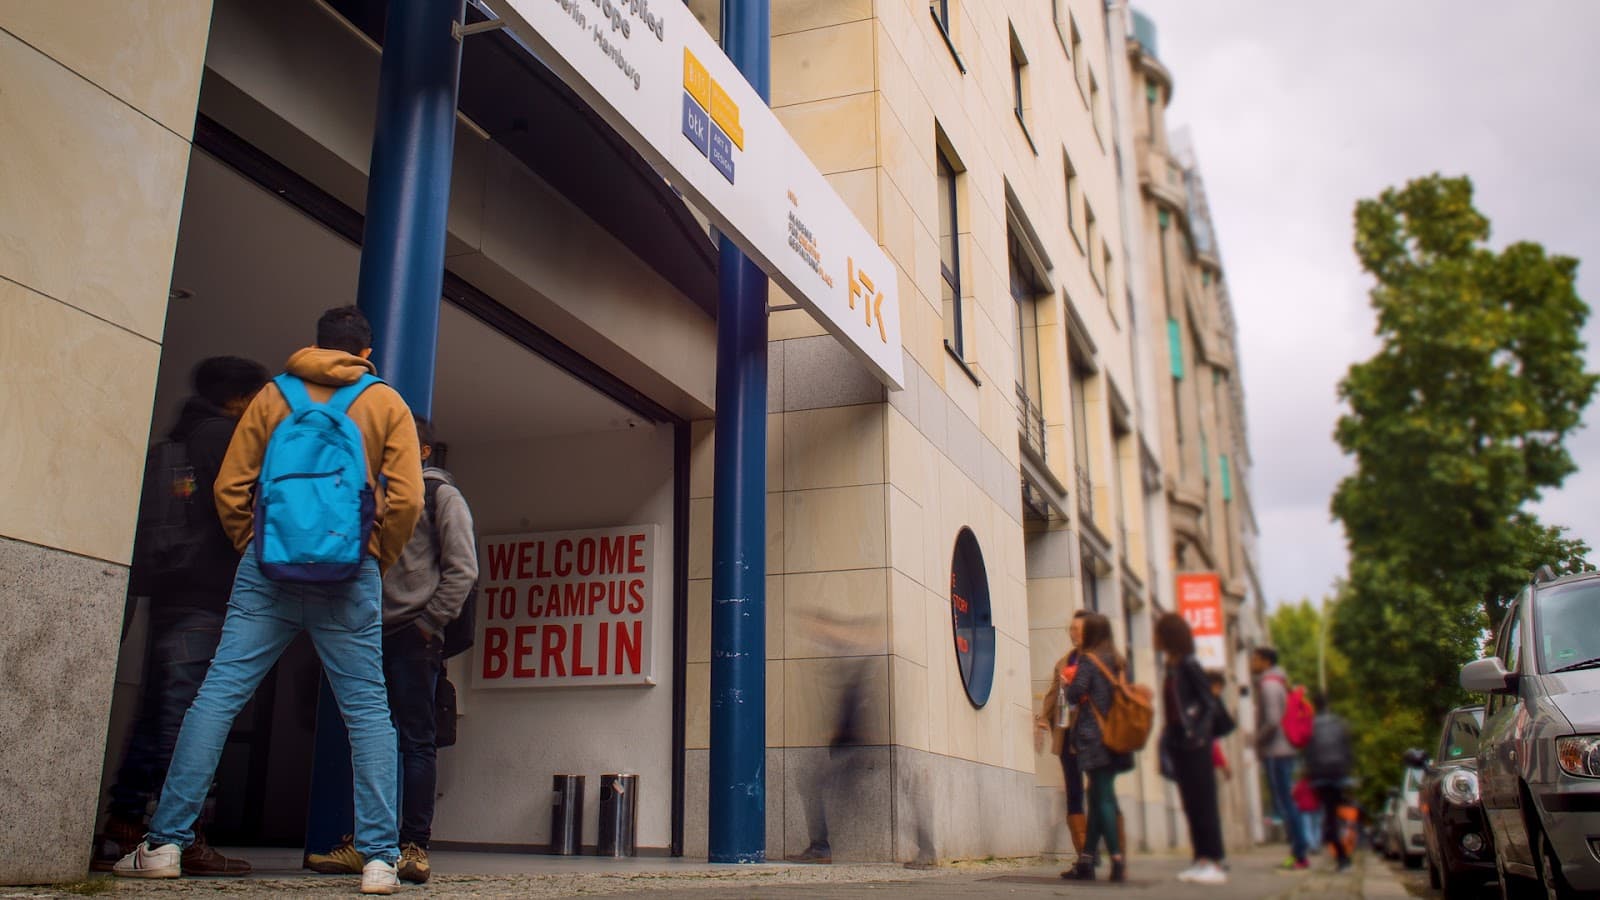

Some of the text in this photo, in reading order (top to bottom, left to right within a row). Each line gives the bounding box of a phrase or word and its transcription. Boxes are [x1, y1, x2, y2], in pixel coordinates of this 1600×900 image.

[621, 0, 664, 42] plied
[555, 0, 641, 91] erlin Hamburg
[688, 106, 704, 141] btk
[713, 148, 732, 173] DESIGN
[487, 534, 646, 581] WELCOME
[485, 579, 645, 620] TO CAMPUS
[482, 621, 642, 679] BERLIN
